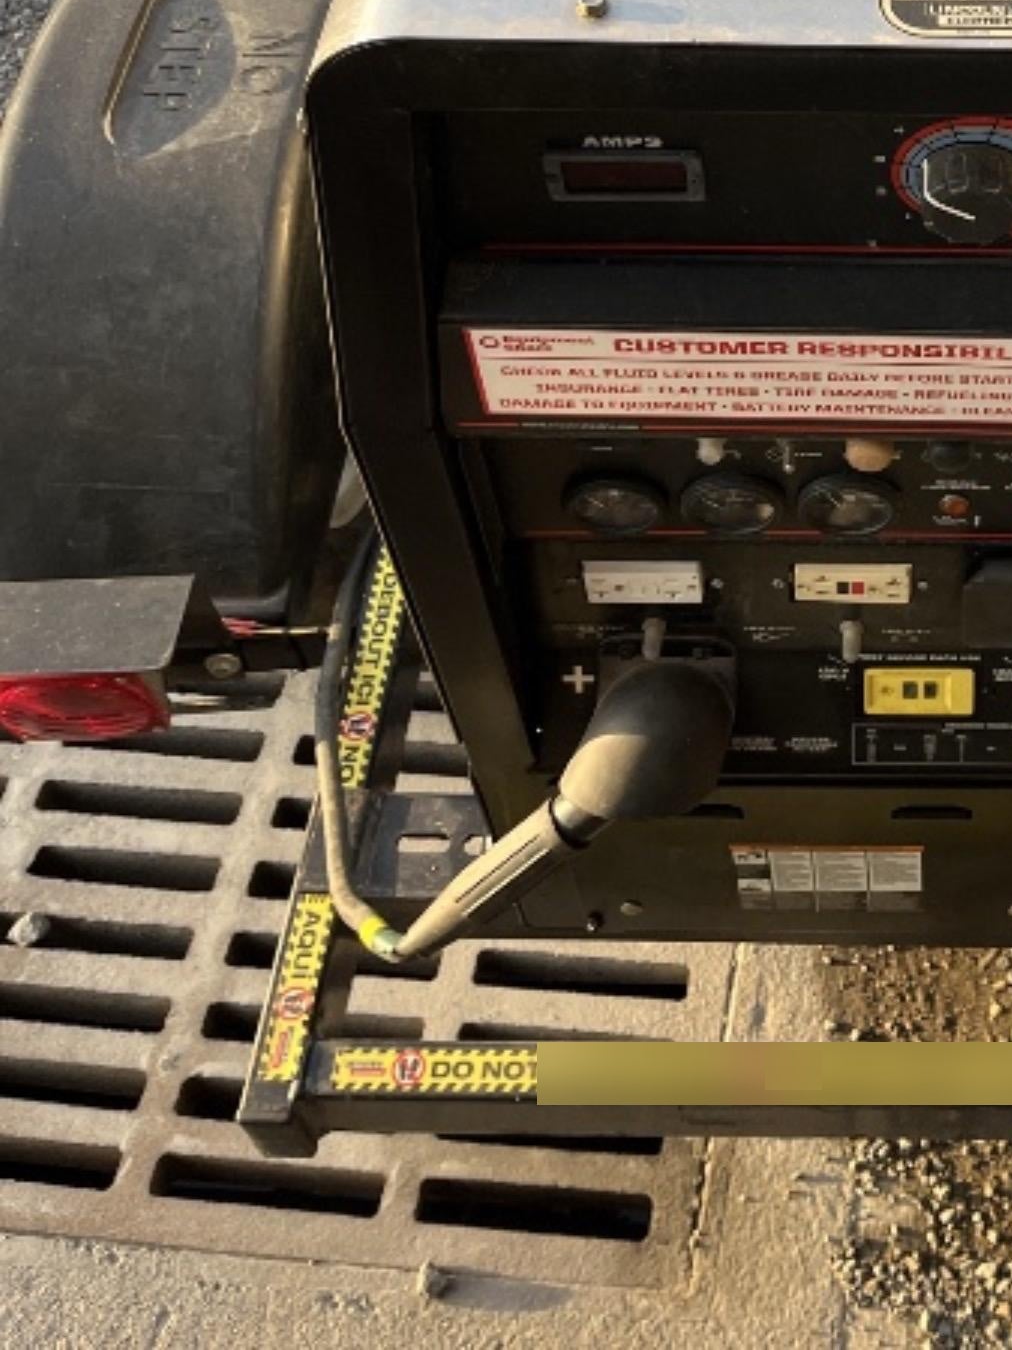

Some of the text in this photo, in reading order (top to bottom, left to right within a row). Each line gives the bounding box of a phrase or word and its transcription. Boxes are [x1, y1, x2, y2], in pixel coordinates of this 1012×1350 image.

[581, 136, 663, 148] AMPS
[613, 338, 789, 356] CUSTOMER
[500, 366, 562, 377] CHECK
[567, 368, 599, 378] ALL
[602, 368, 659, 379] FLUID
[662, 369, 729, 380] LEVELS
[750, 371, 822, 382] GREASE
[827, 372, 880, 383] DAILY
[884, 374, 954, 385] BEFORE
[536, 383, 642, 394] INSURANCE
[658, 385, 699, 395] FLAT
[704, 386, 760, 397] TIRES
[773, 387, 816, 398] TIRE
[821, 388, 898, 399] DAMAGE
[500, 399, 577, 409] DAMAGE
[583, 400, 604, 410] TO
[608, 401, 717, 412] EQUIPMENT
[731, 402, 811, 413] BATTERY
[815, 403, 945, 415] MAINTENANCE
[342, 745, 360, 787] NO
[431, 1061, 475, 1080] DO
